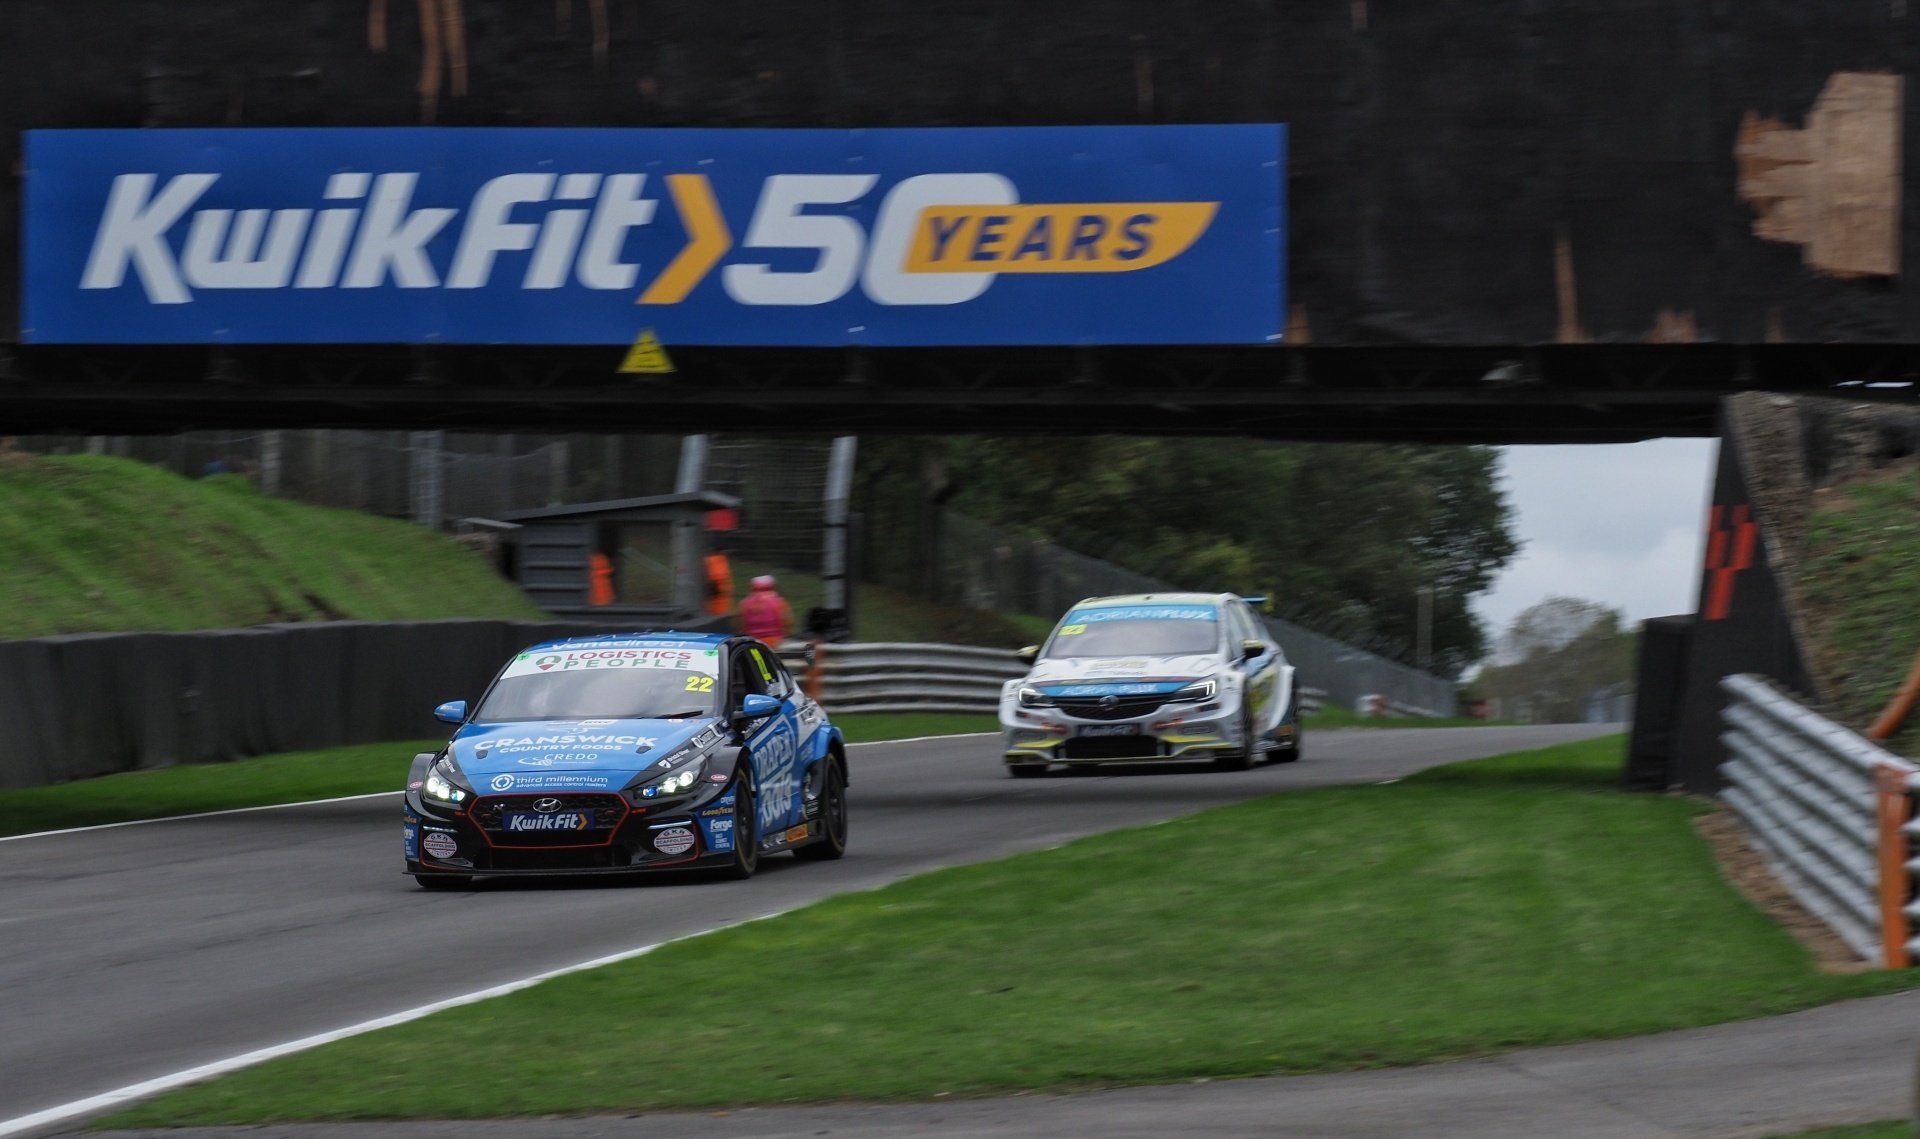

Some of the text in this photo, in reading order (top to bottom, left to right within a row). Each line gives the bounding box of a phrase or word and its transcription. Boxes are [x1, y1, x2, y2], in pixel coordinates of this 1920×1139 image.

[722, 172, 1020, 305] 50
[927, 213, 1162, 262] YEARS
[567, 650, 692, 661] LOGISTICS
[563, 658, 690, 669] PEOPLE
[684, 675, 715, 693] 22
[474, 735, 659, 751] CRANSWICK
[499, 743, 623, 754] COUNTRY FOODS
[544, 753, 598, 761] CREDO
[516, 775, 609, 784] third millennium
